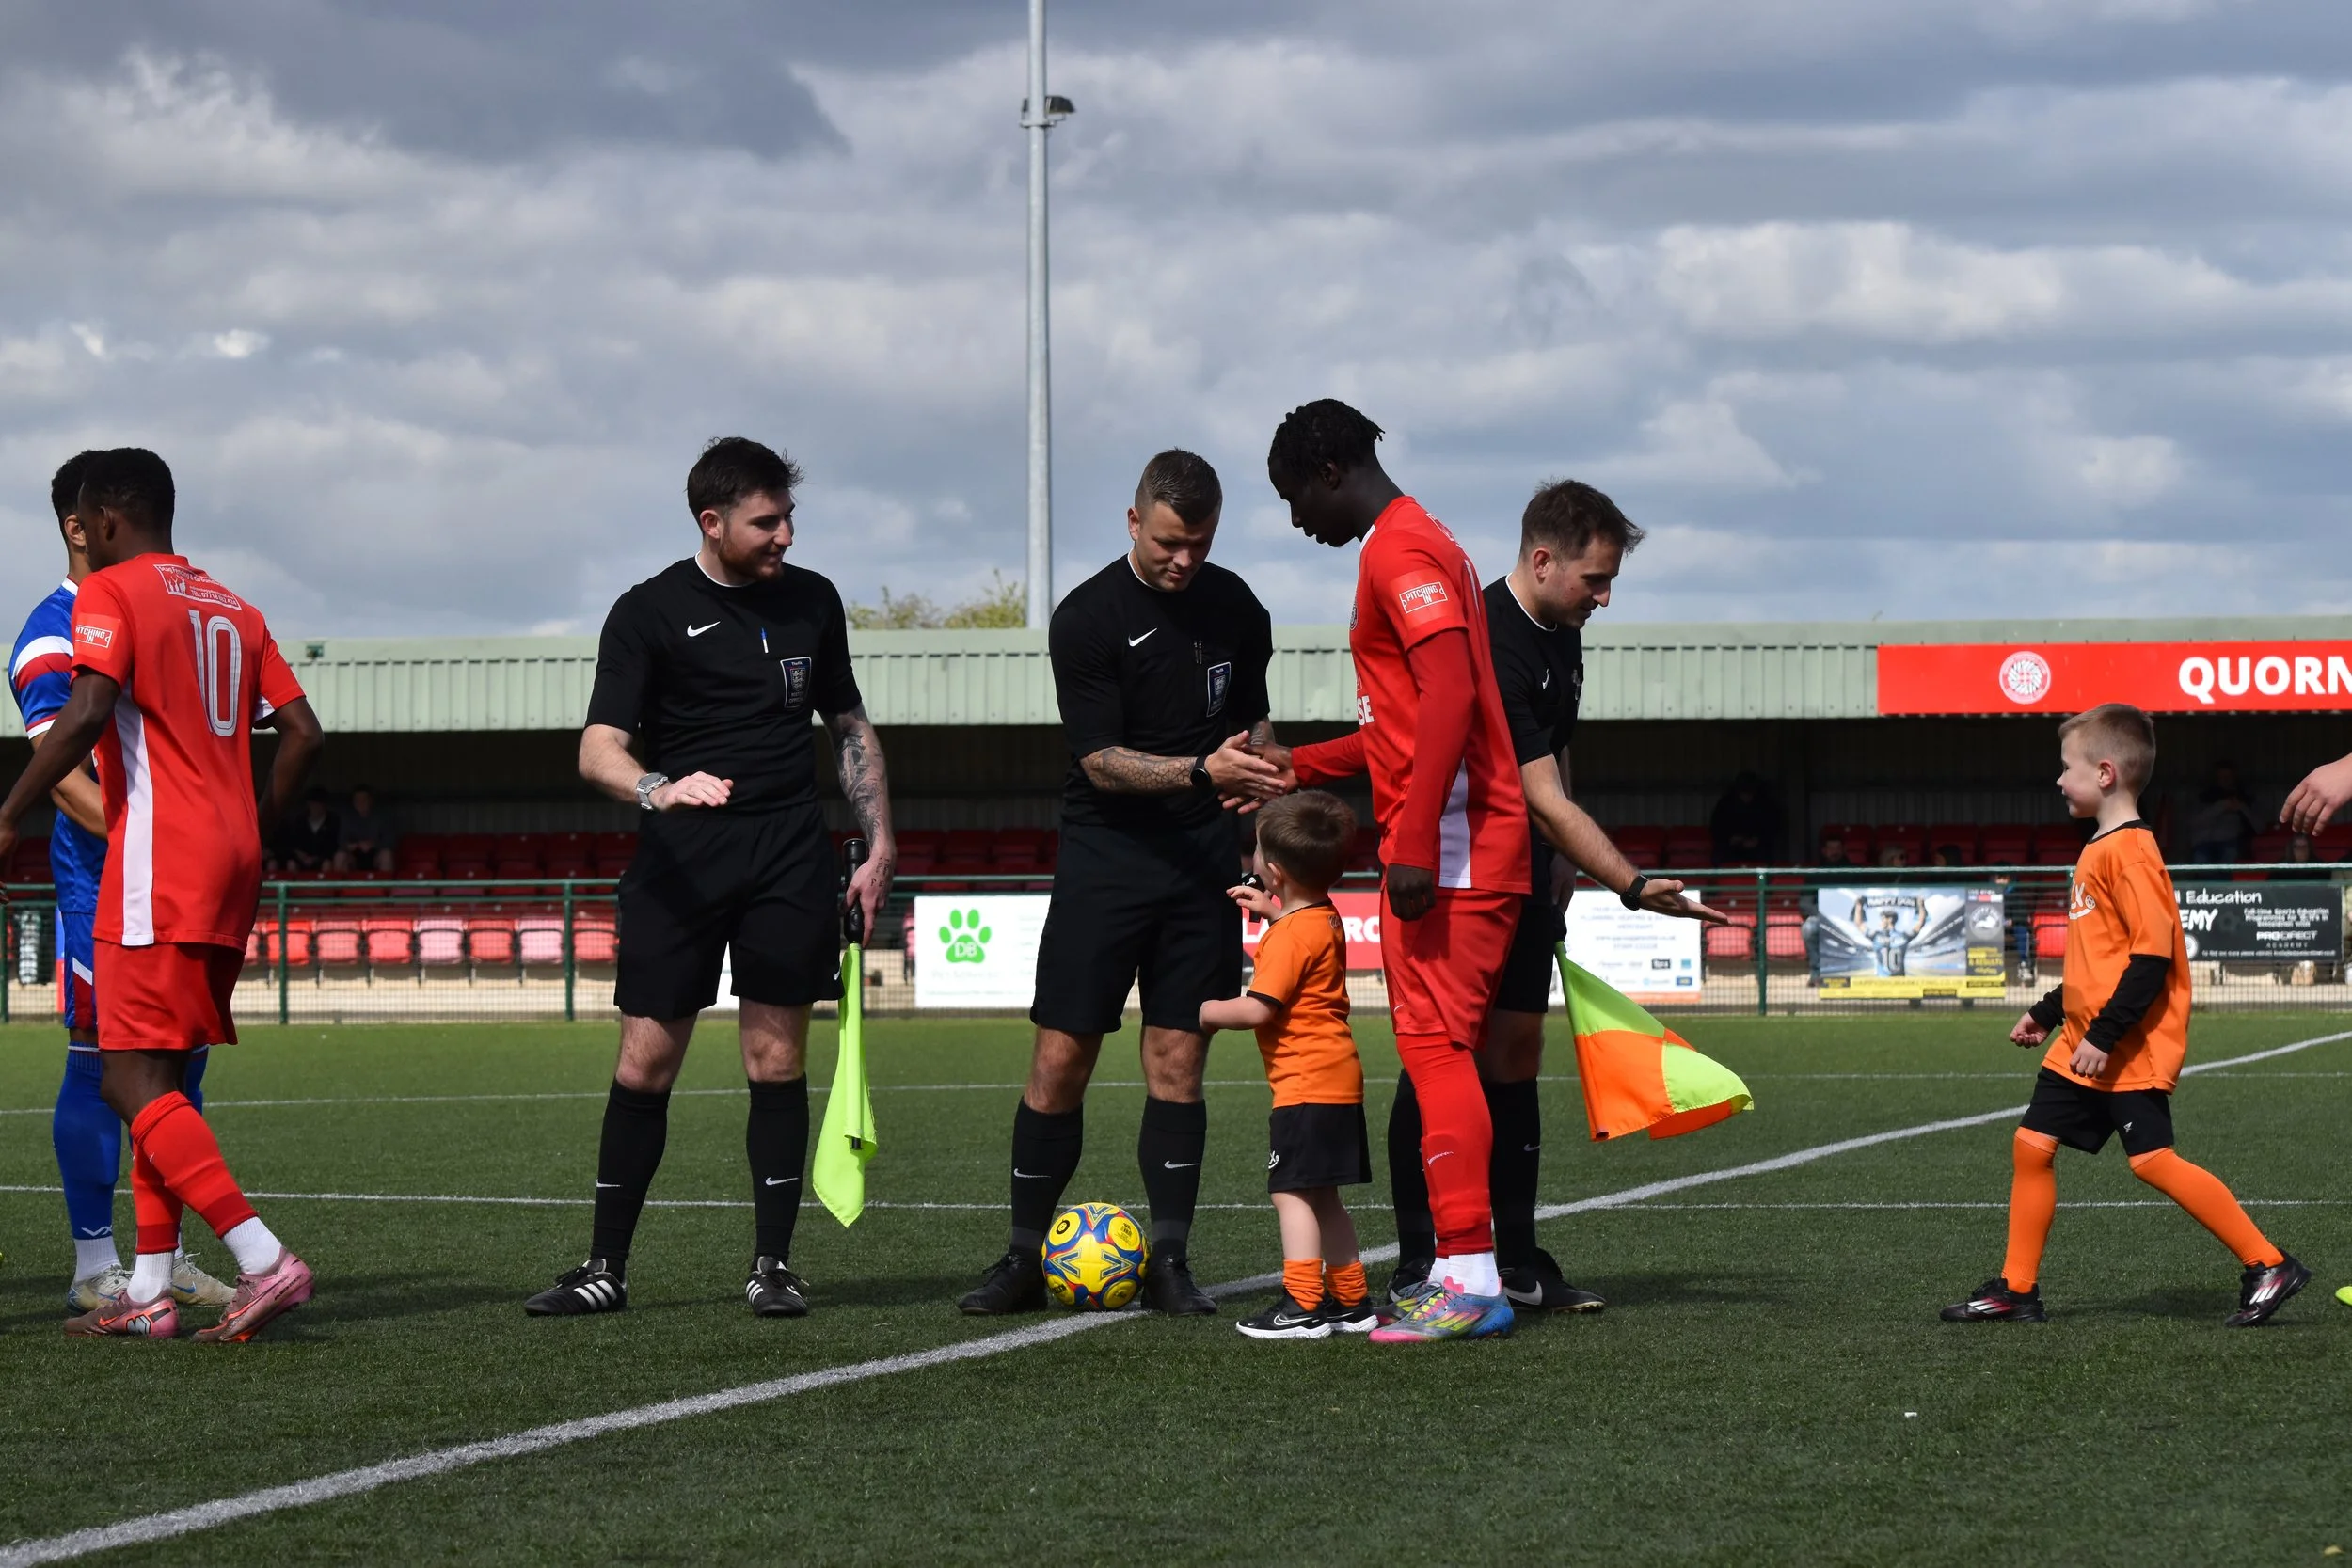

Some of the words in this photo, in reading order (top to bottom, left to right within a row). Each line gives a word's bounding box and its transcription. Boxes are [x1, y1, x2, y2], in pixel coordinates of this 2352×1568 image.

[1406, 585, 1438, 601] PITCHING
[1422, 592, 1432, 604] IN
[86, 633, 94, 642] IN
[188, 610, 242, 737] 10
[2179, 656, 2352, 704] QUORN
[2186, 888, 2262, 905] Education
